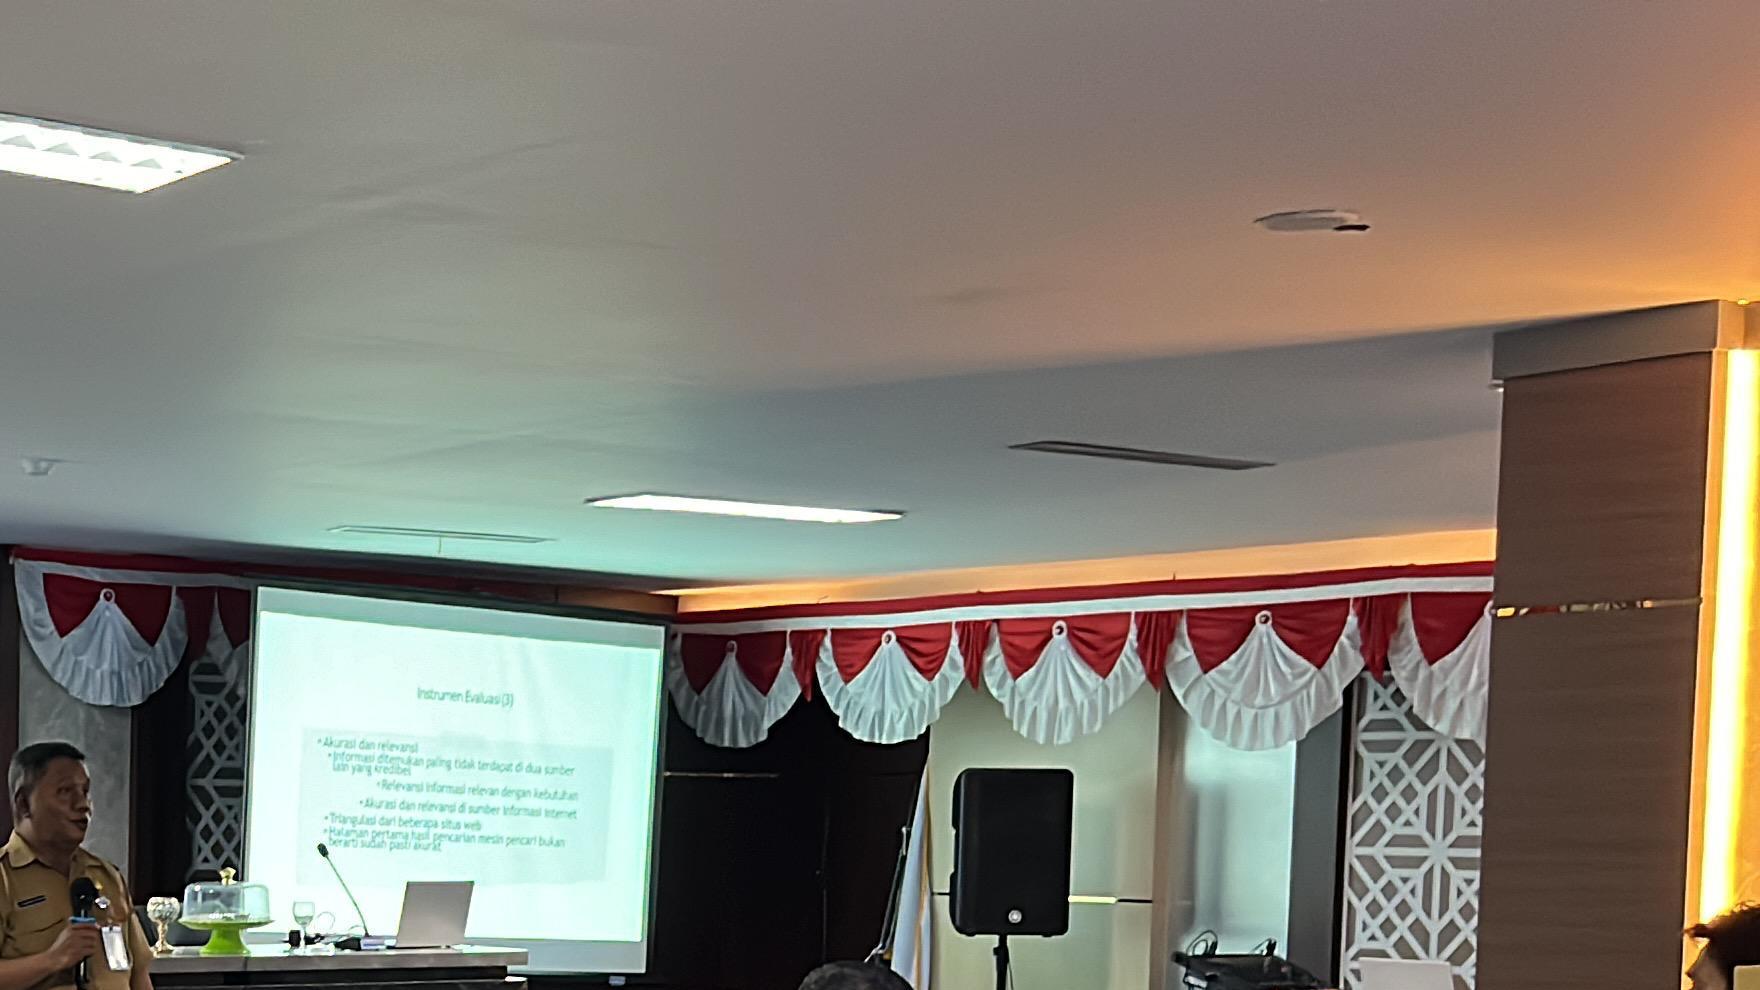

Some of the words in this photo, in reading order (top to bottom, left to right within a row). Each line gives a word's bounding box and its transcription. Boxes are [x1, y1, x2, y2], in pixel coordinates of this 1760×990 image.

[417, 687, 464, 702] Instrumen
[465, 690, 500, 705] Evaluasi
[502, 693, 514, 707] (3)
[323, 737, 356, 750] Akurasi
[359, 739, 376, 751] dan
[378, 741, 419, 753] relevansi
[333, 751, 375, 764] Informasi
[426, 757, 452, 770] paling
[454, 758, 476, 770] tidak
[478, 760, 513, 774] terdapat
[525, 763, 542, 774] dua
[544, 764, 575, 776] sumber
[381, 779, 424, 793] Relevansi
[426, 780, 466, 795] informasi
[468, 783, 499, 797] relevan
[501, 785, 532, 800] dengan
[363, 799, 397, 812] Akurasi
[399, 801, 416, 813] dan
[418, 803, 456, 815] relevansi
[458, 804, 466, 815] di
[468, 805, 500, 818] sumber
[503, 805, 542, 818] informasi
[329, 812, 376, 828] Triangulasi
[378, 816, 396, 827] dari
[398, 817, 439, 831] beberapa
[463, 821, 482, 832] web
[329, 827, 369, 840] Halaman
[539, 836, 566, 848] bukan
